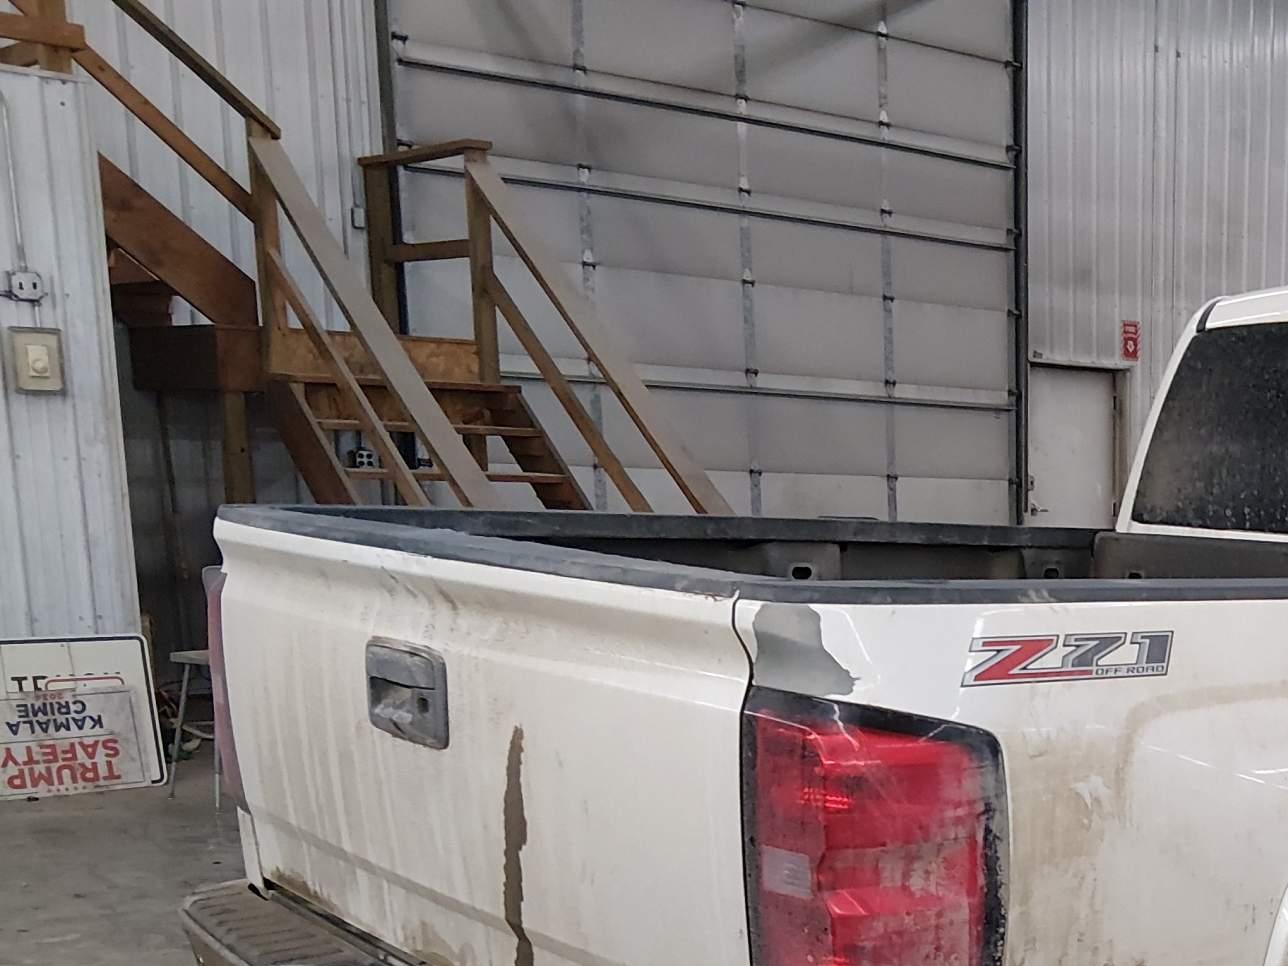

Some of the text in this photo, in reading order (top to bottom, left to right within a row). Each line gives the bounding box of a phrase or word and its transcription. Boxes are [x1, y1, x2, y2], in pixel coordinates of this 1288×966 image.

[961, 631, 1174, 687] Z71
[1095, 664, 1165, 676] OFF ROAD
[16, 699, 87, 719] CRIME
[5, 714, 104, 736] KAMALA
[0, 739, 120, 768] SAFETY
[7, 760, 122, 790] TRUMP
